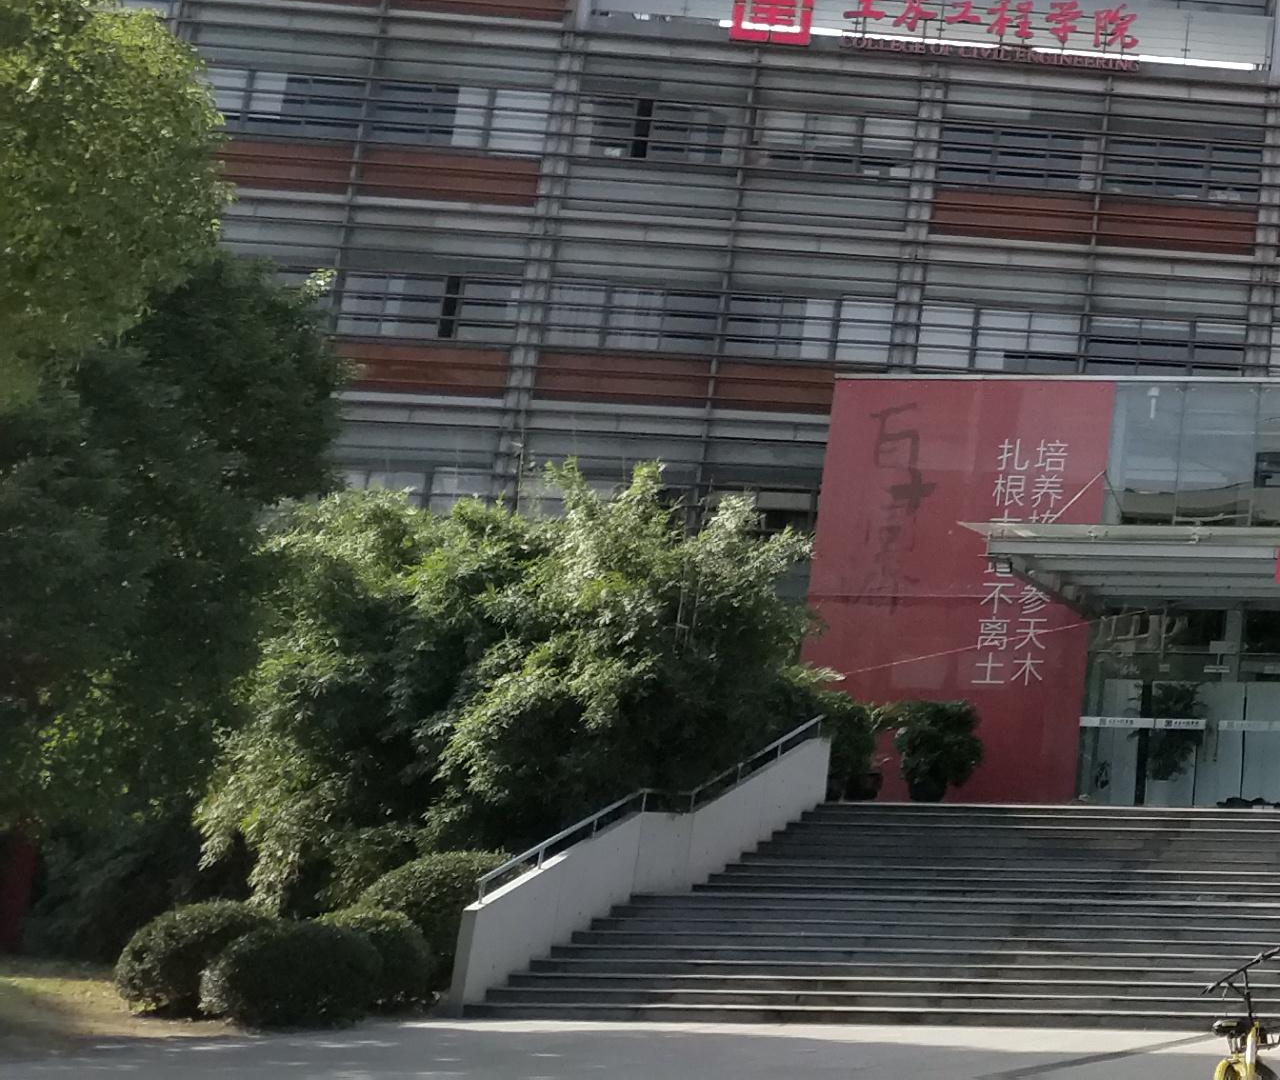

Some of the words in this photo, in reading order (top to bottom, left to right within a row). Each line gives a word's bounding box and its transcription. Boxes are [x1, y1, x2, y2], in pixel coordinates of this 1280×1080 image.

[840, 35, 926, 55] COLLEGE
[931, 42, 951, 56] OF
[958, 45, 1009, 60] CIVIL
[1012, 48, 1140, 71] ENGINEERING
[1011, 438, 1068, 686] 培养参天木
